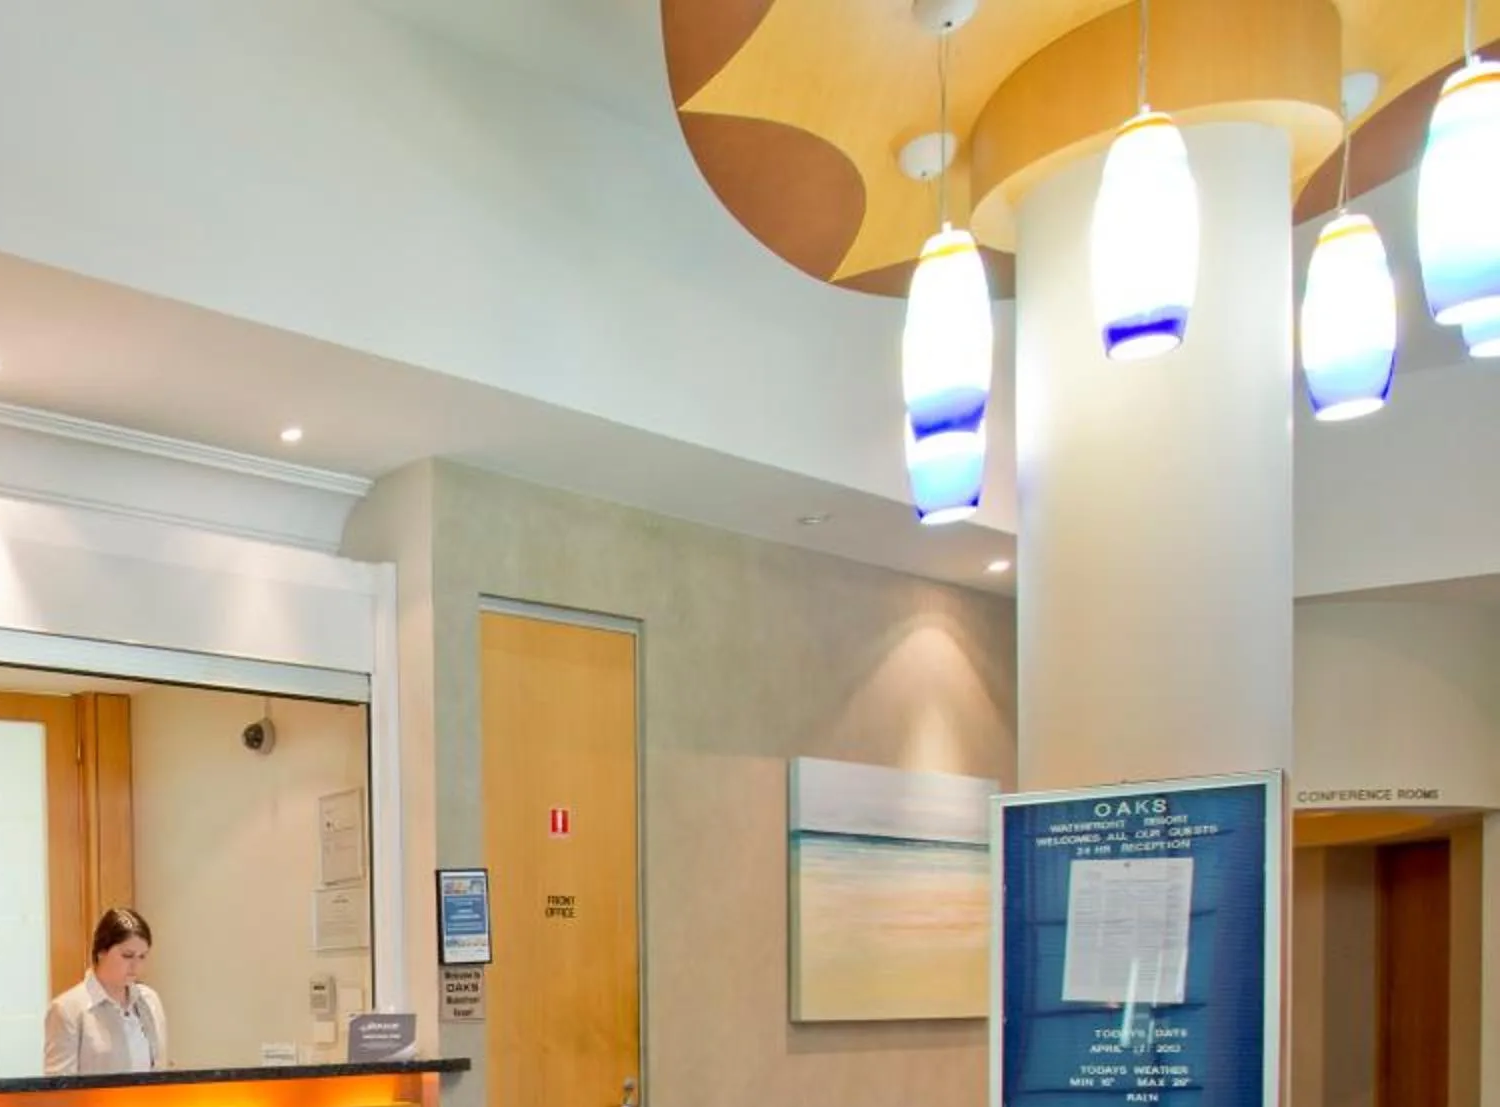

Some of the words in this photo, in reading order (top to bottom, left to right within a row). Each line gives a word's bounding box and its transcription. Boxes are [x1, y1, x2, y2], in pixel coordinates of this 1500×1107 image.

[1297, 789, 1392, 803] CONFERENCE
[1397, 788, 1440, 800] ROOMS
[1094, 799, 1167, 816] OAKS
[1036, 834, 1100, 847] WELCOMES
[1107, 833, 1127, 842] ALL
[1135, 829, 1160, 839] OUR
[1168, 825, 1218, 837] GUESTS
[1120, 839, 1191, 853] RECEPTION
[547, 895, 575, 905] FRONT
[545, 907, 576, 918] OFFICE
[446, 983, 479, 992] OAKS
[1081, 1065, 1128, 1075] TODAYS
[1133, 1065, 1189, 1075] WEATHER
[1069, 1078, 1094, 1087] MIN
[1137, 1078, 1165, 1087] MAX
[1126, 1093, 1158, 1102] RAIN
